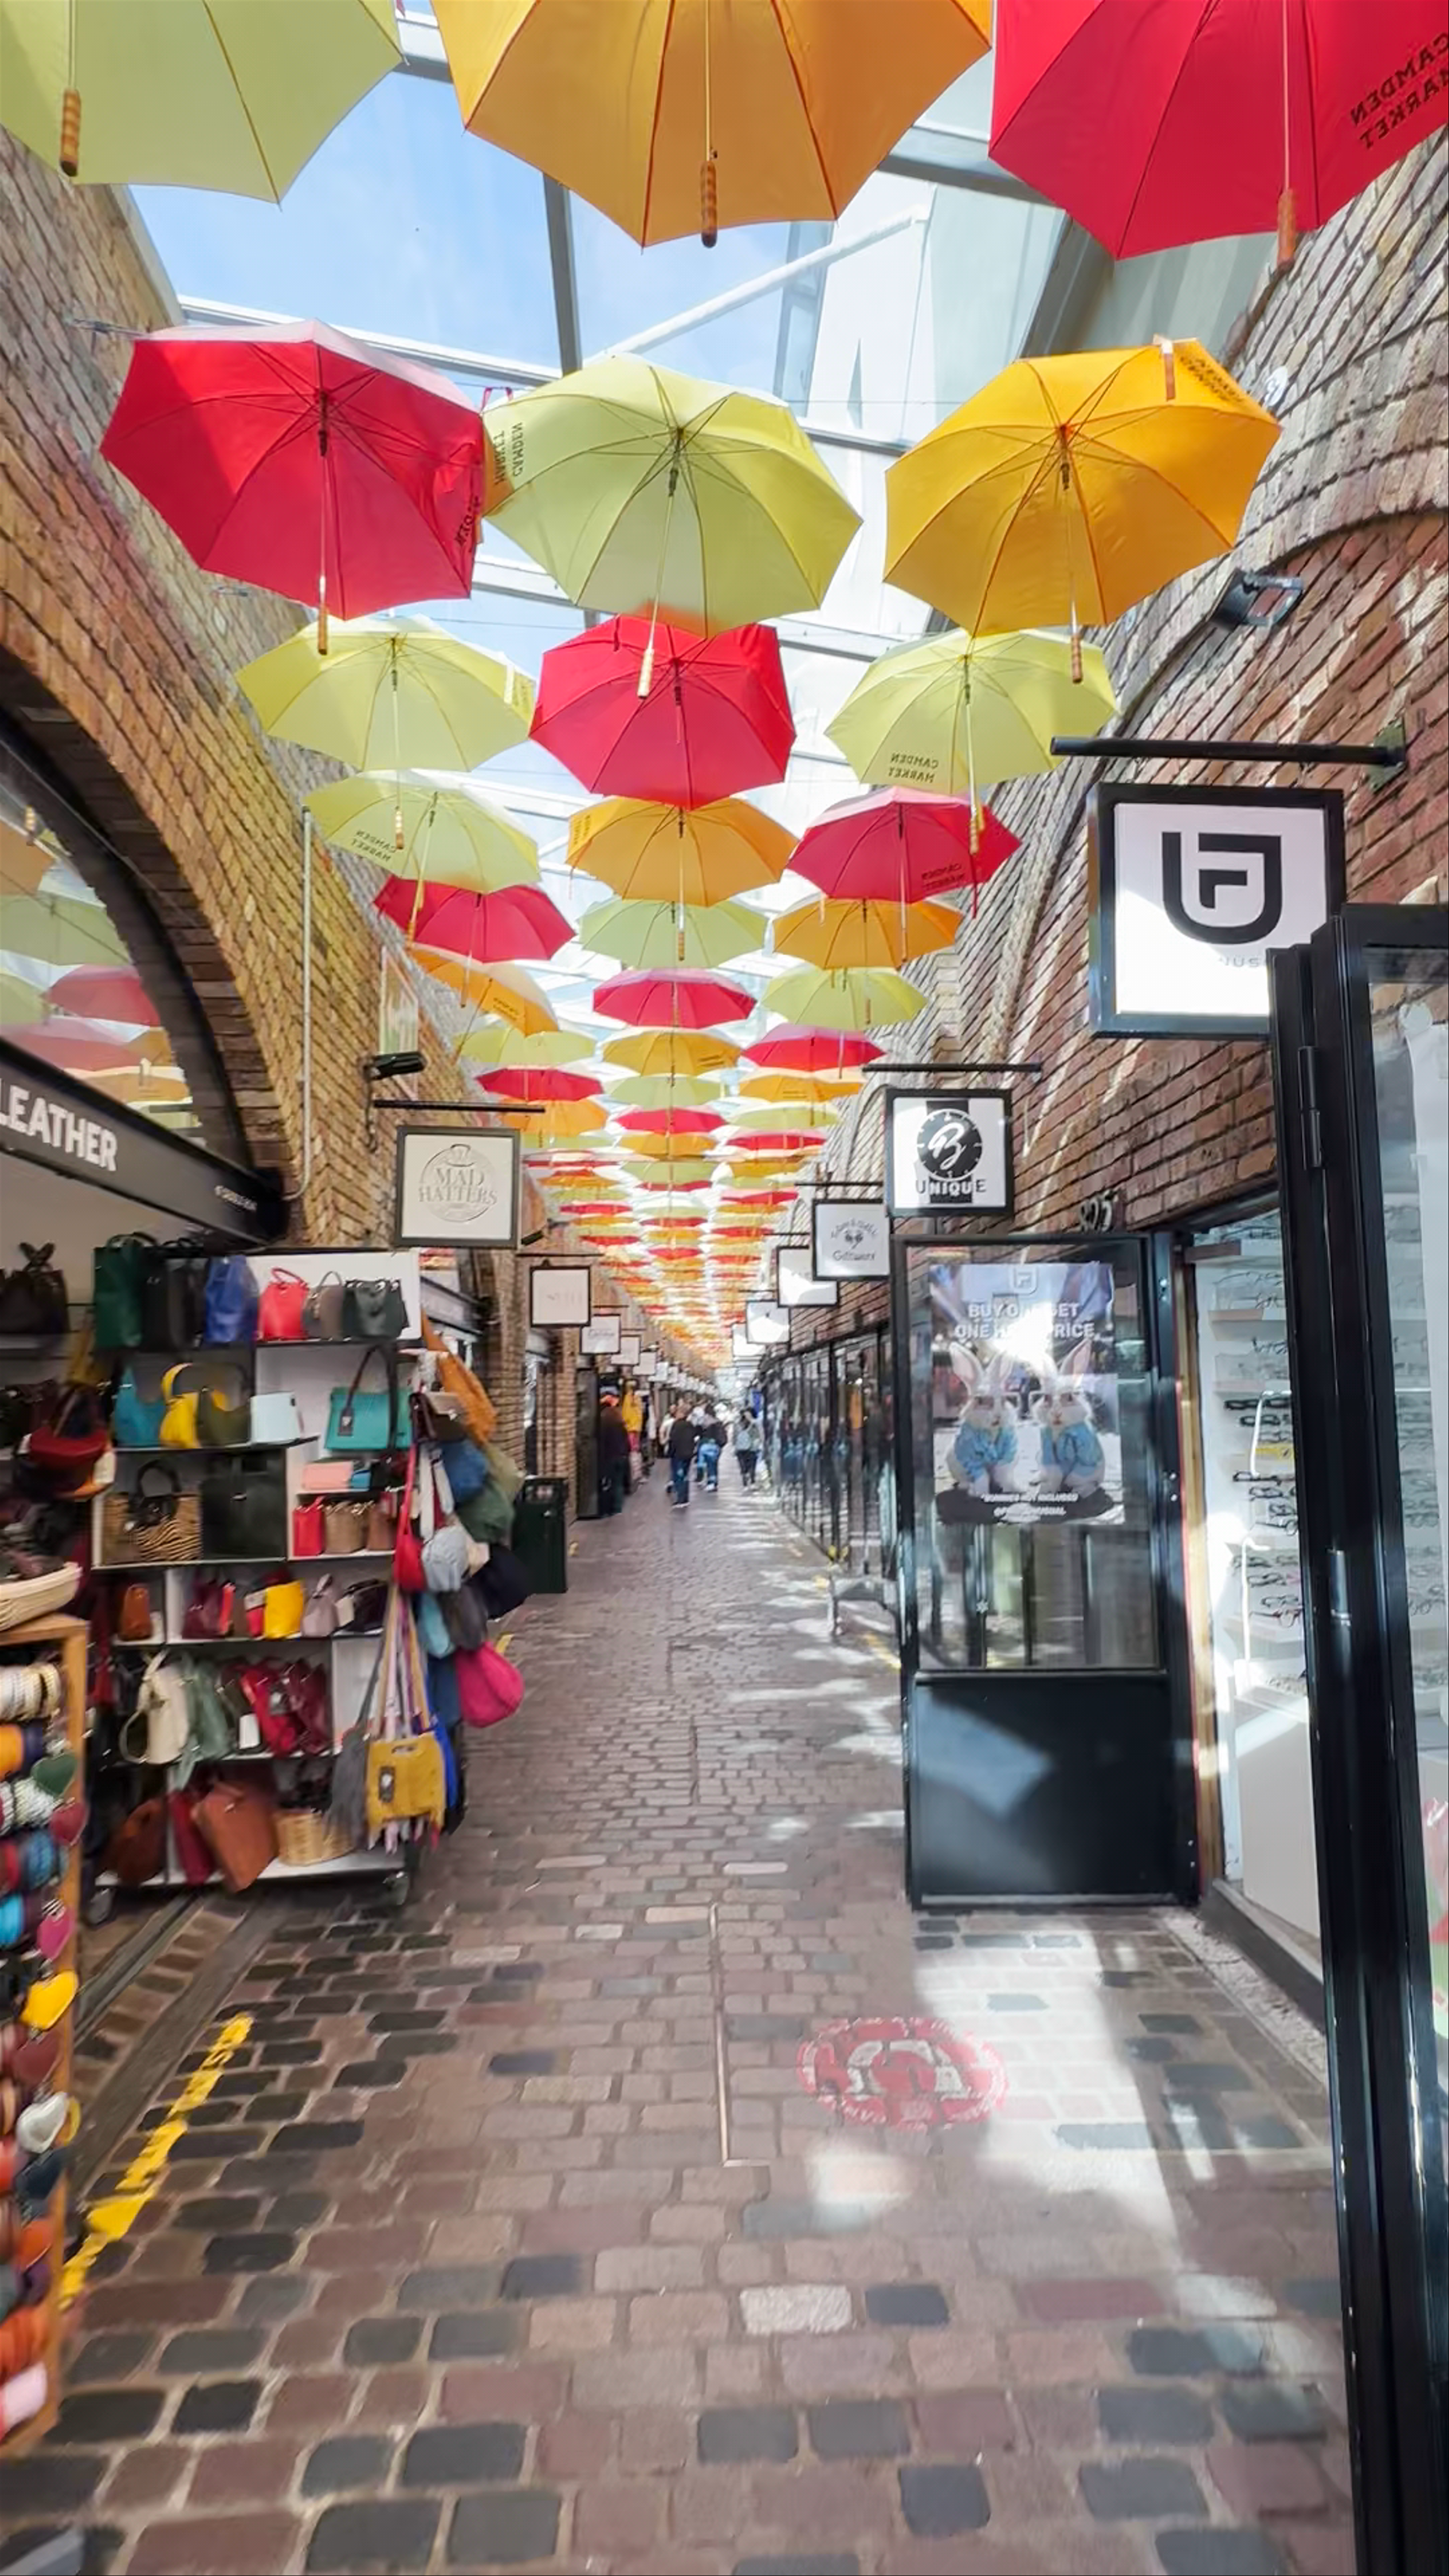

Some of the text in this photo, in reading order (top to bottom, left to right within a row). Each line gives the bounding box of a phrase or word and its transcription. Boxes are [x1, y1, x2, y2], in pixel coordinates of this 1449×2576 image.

[0, 1078, 117, 1171] LEATHER
[435, 1167, 485, 1186] MAD
[418, 1185, 498, 1206] HATTERS
[915, 1178, 987, 1196] UNIQUE
[968, 1304, 1004, 1318] BUY
[954, 1324, 990, 1338] ONE
